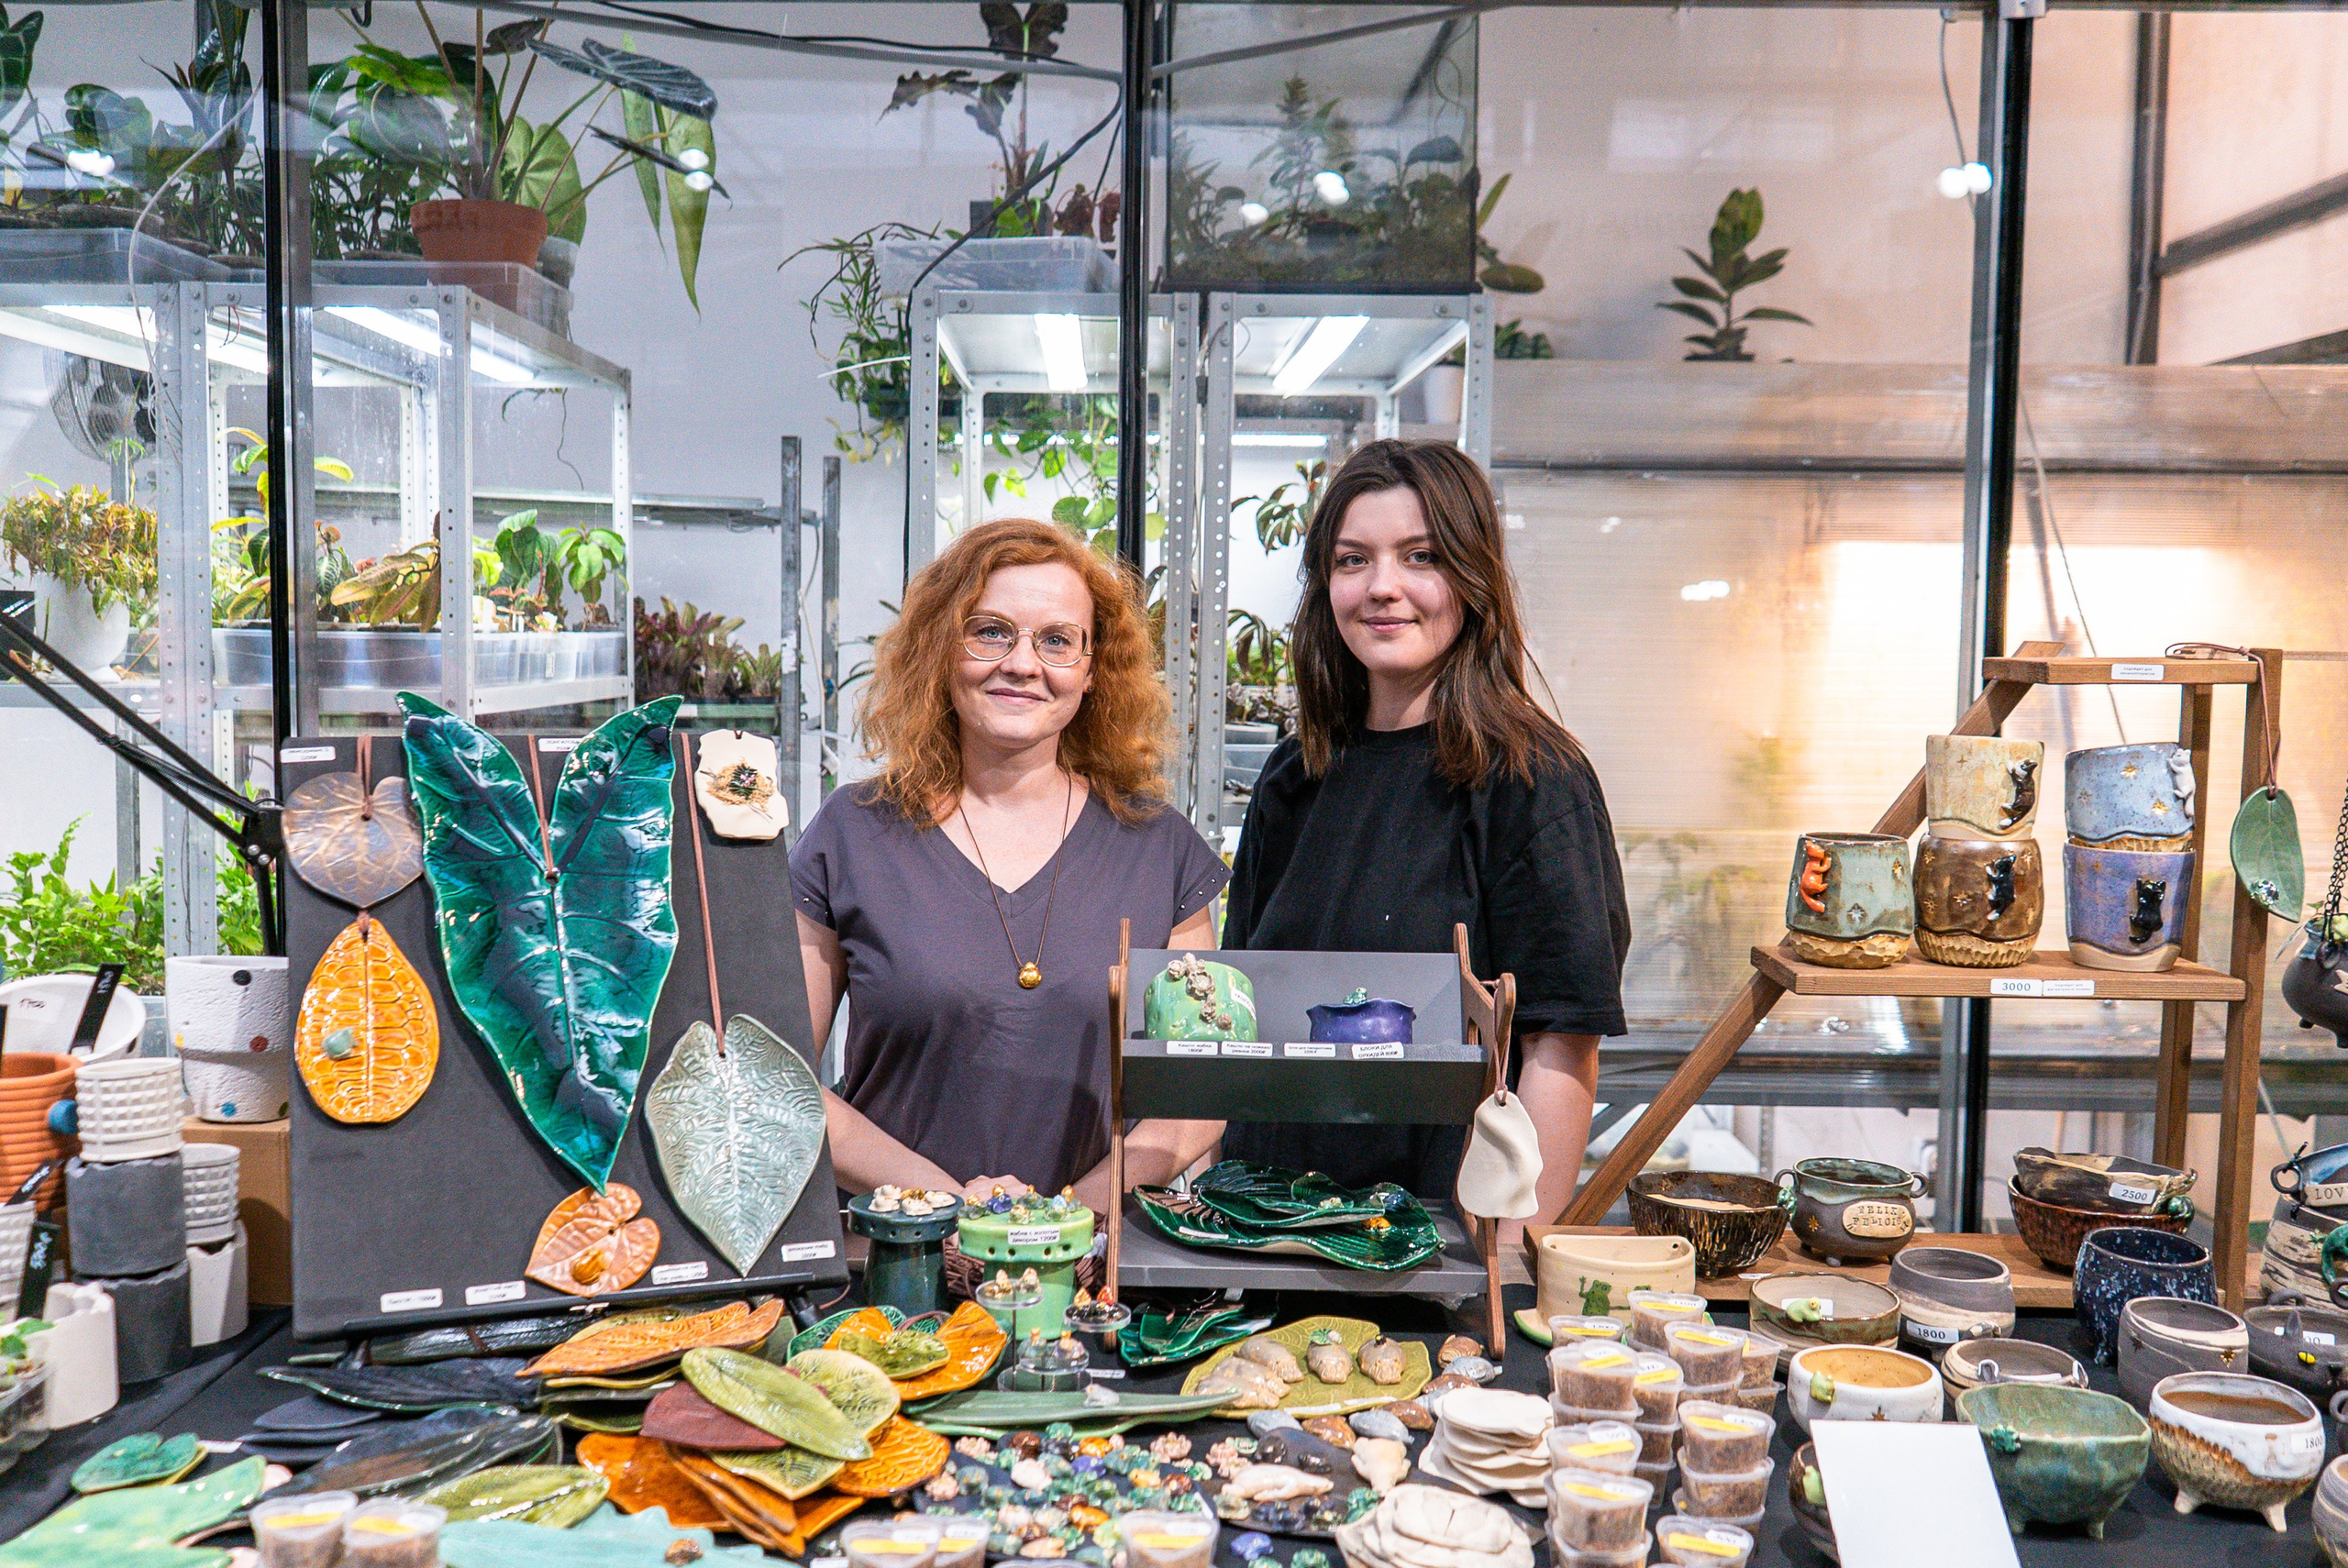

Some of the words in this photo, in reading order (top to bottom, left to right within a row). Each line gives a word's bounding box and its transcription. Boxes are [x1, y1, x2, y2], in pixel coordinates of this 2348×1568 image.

[2002, 982, 2031, 991] 3000
[2121, 1189, 2147, 1200] 2500
[2315, 1187, 2348, 1199] LOV
[1858, 1205, 1898, 1215] FELIX
[1918, 1328, 1945, 1339] 1800
[2305, 1435, 2323, 1449] 1800
